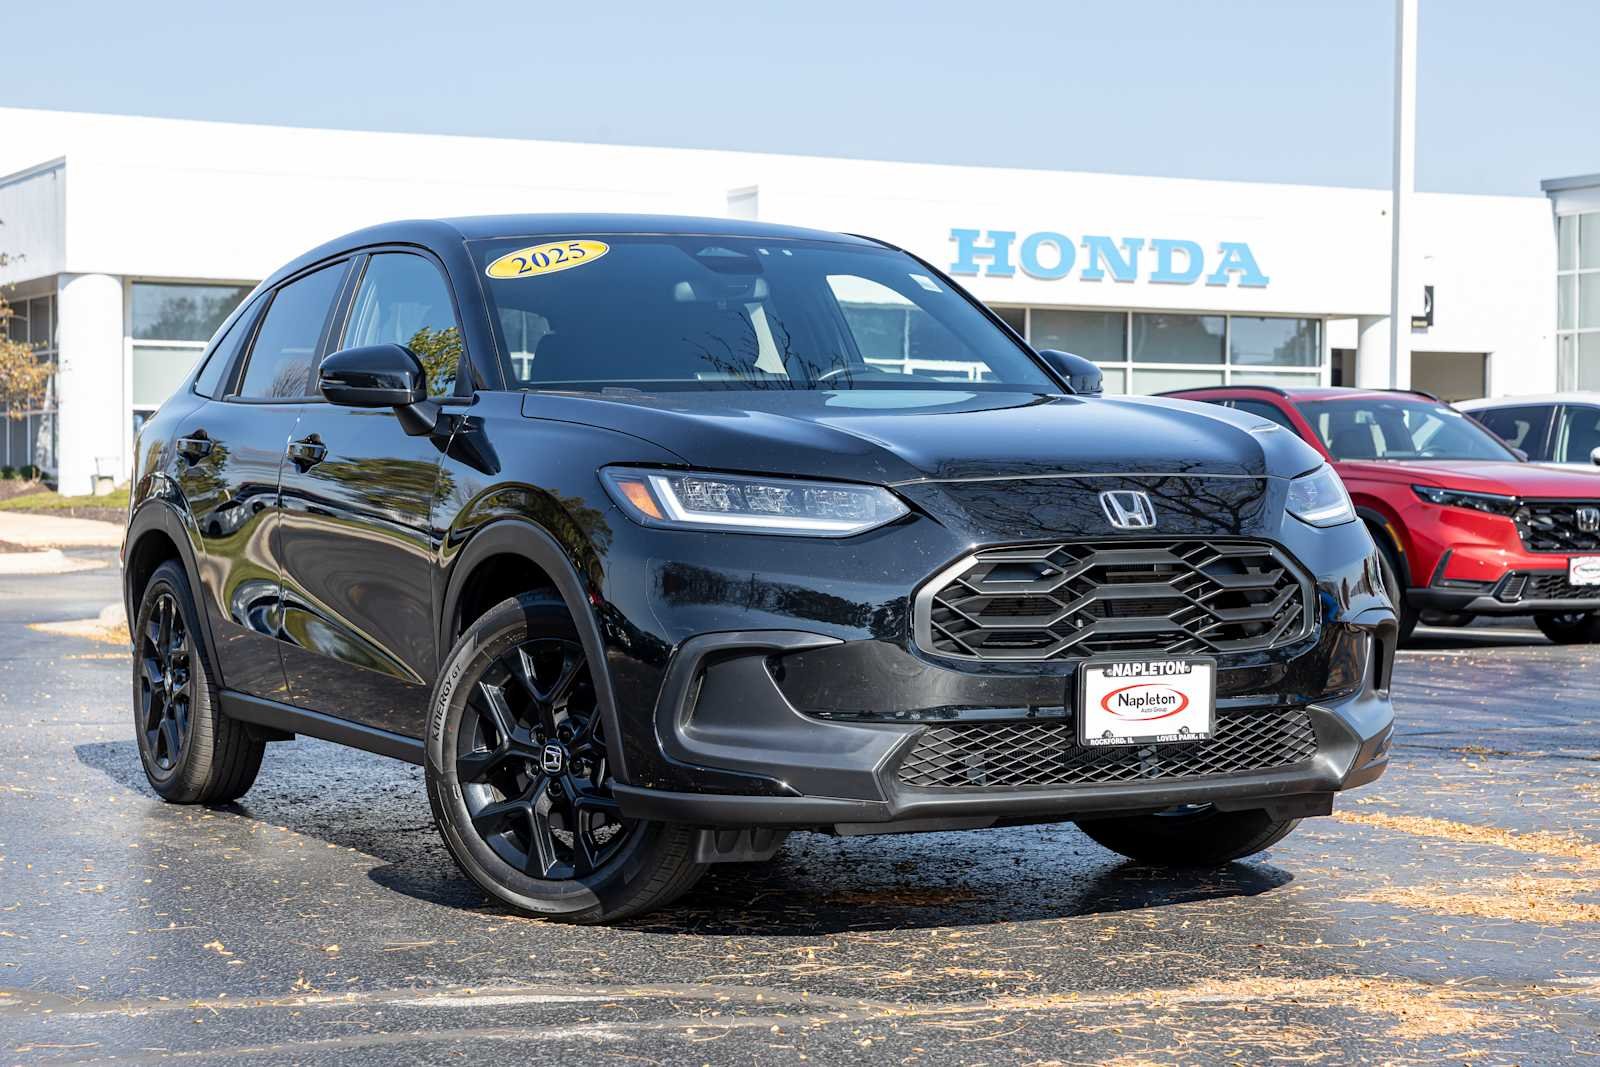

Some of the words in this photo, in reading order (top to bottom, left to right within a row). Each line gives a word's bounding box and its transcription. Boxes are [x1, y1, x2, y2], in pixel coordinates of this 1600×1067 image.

[511, 243, 586, 274] 2025
[949, 228, 1270, 289] HONDA
[1112, 661, 1185, 677] NAPLETON
[1118, 691, 1176, 709] Napleton
[1127, 736, 1135, 744] IL
[1156, 734, 1178, 742] LOVES
